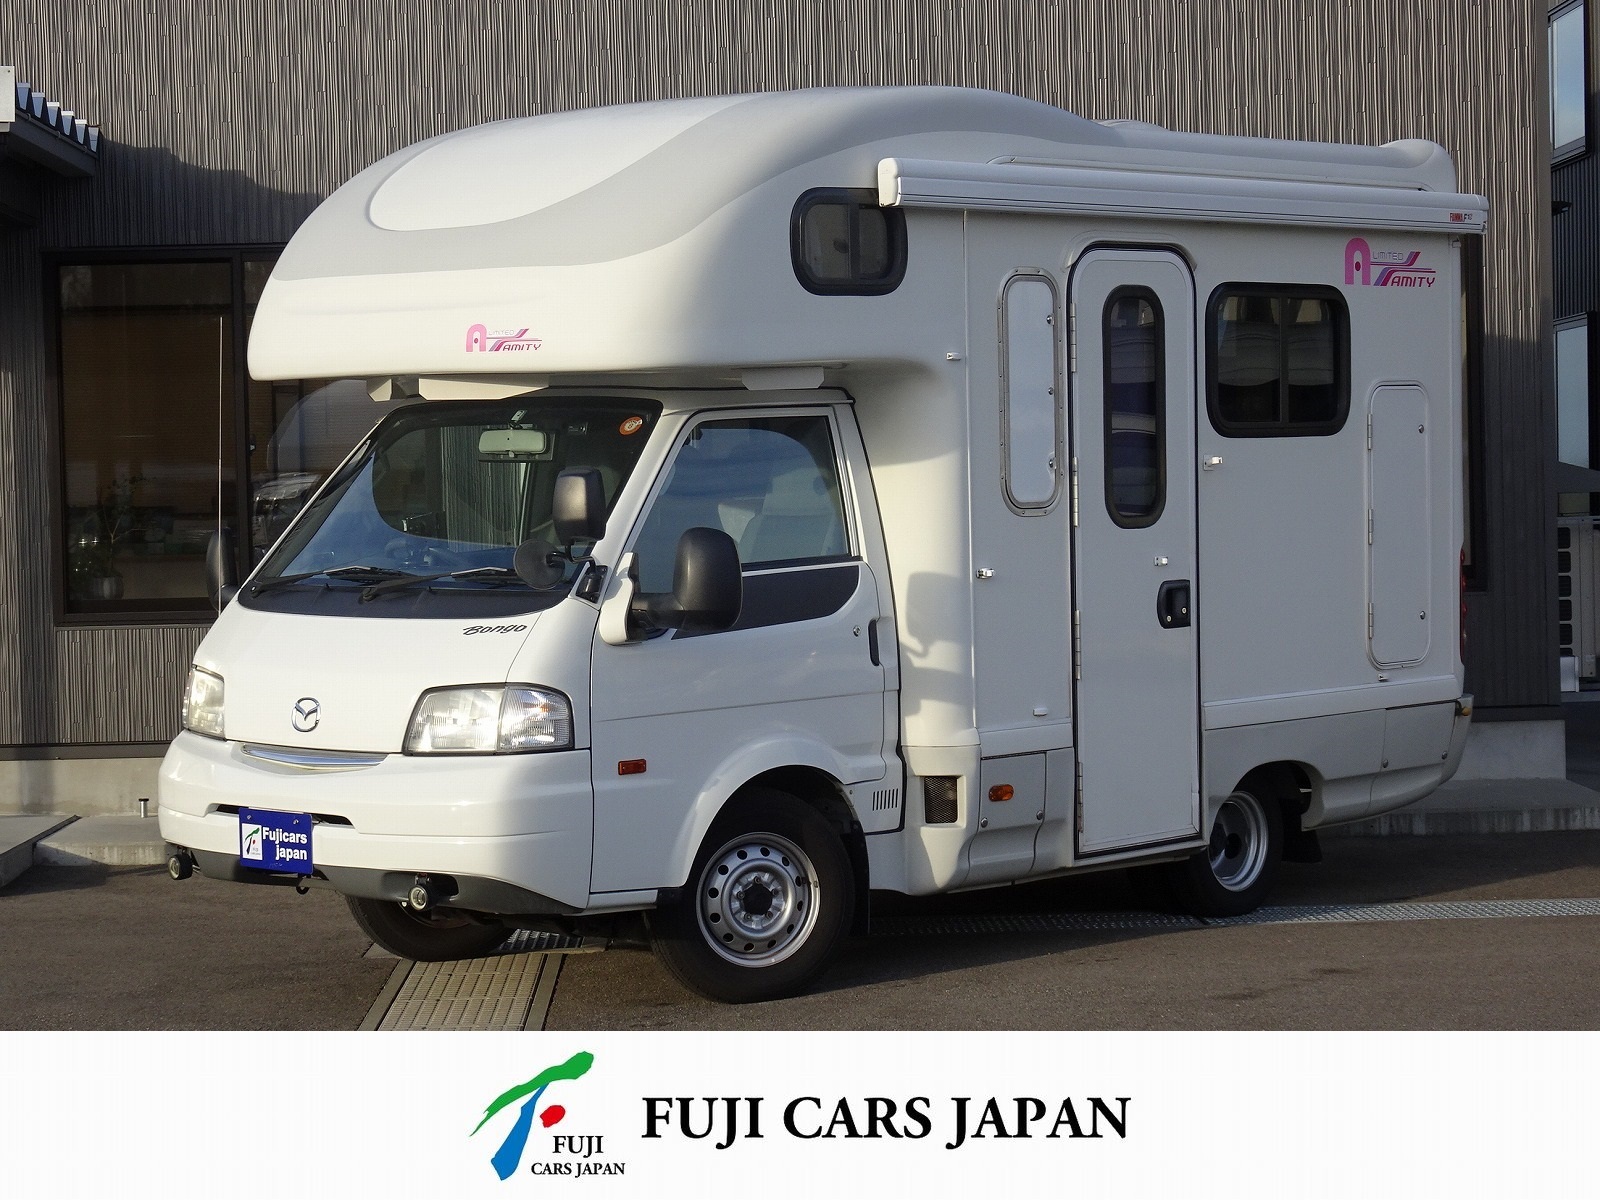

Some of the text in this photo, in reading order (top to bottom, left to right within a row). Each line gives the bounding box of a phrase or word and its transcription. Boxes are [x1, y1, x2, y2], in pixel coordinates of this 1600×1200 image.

[1372, 251, 1404, 261] LIMITED
[1390, 275, 1436, 288] AMITY
[502, 343, 542, 352] AMITY
[462, 624, 528, 636] Bongo
[262, 826, 308, 845] Fujicars
[275, 844, 308, 862] japan
